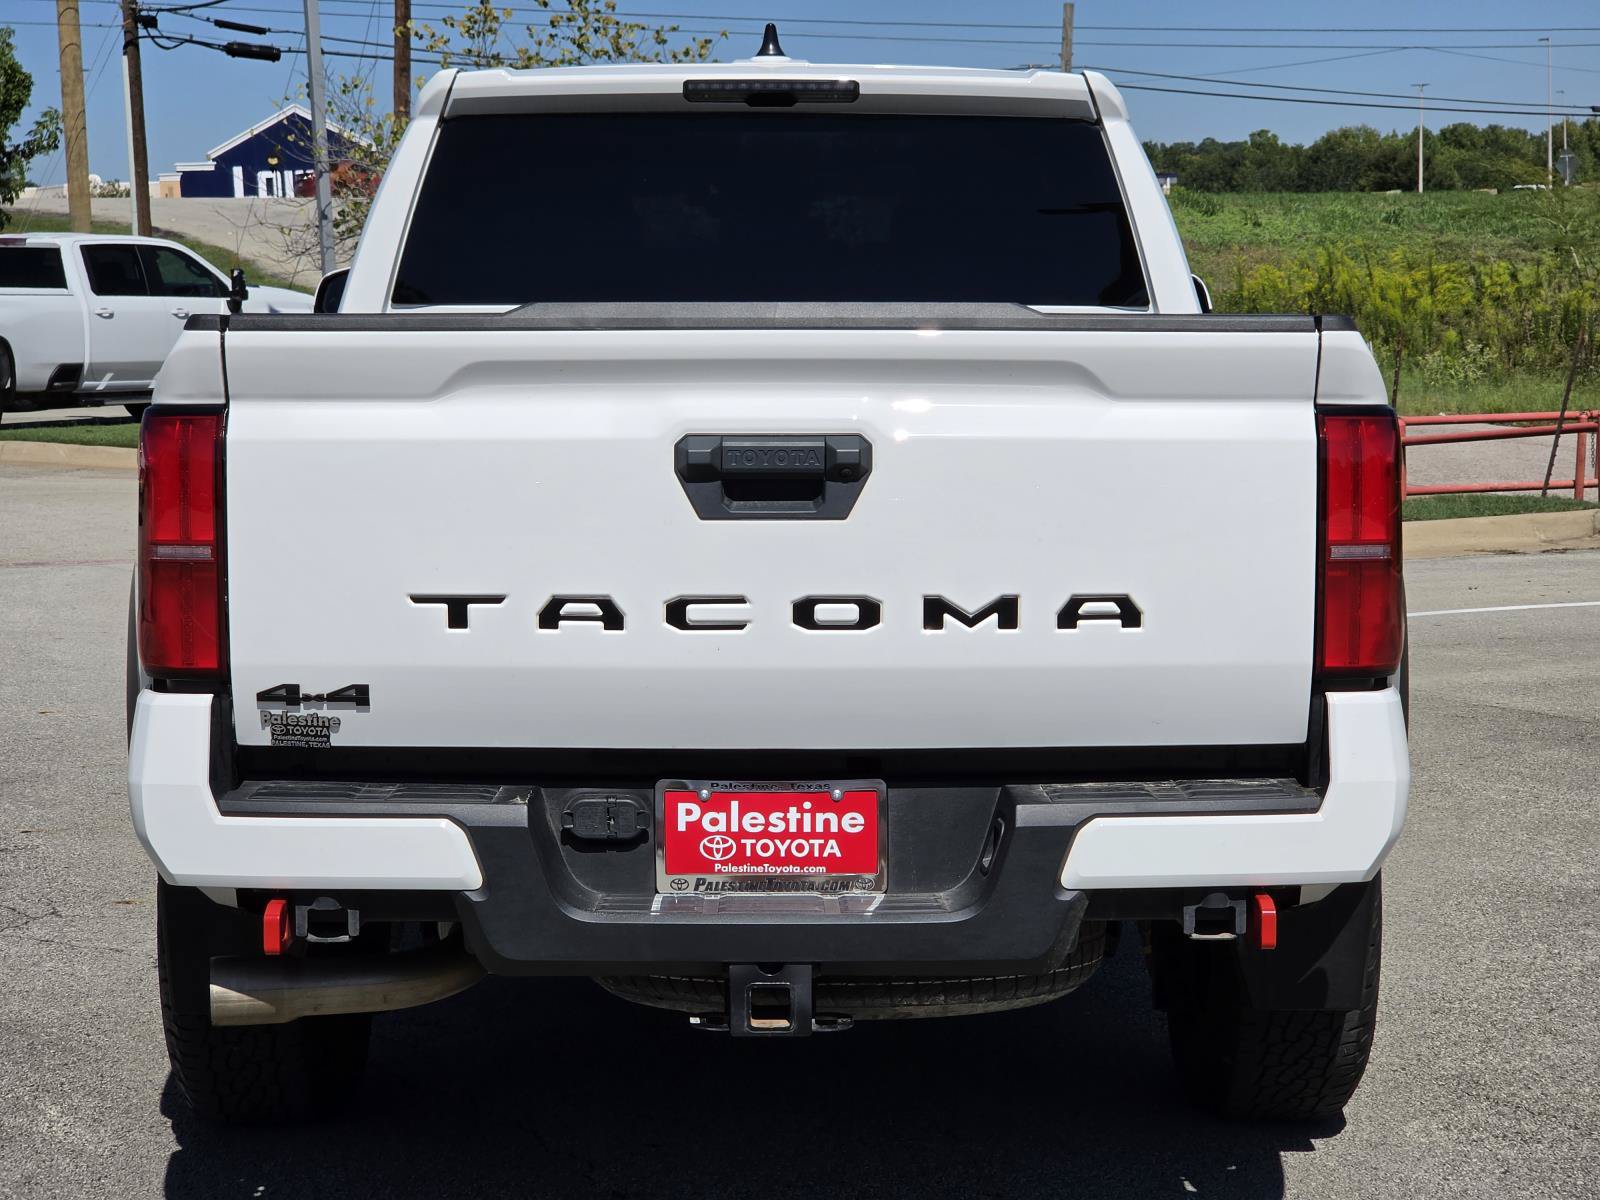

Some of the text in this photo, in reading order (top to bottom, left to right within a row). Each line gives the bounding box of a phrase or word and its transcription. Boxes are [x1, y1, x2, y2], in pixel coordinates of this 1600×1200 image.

[727, 449, 821, 466] TOYOTA
[407, 594, 1144, 631] TACOMA
[260, 710, 341, 727] Palestine
[287, 726, 329, 735] TOYOTA
[677, 800, 865, 833] Palestine
[741, 839, 842, 858] TOYOTA
[714, 862, 827, 875] PalestineToyota.com
